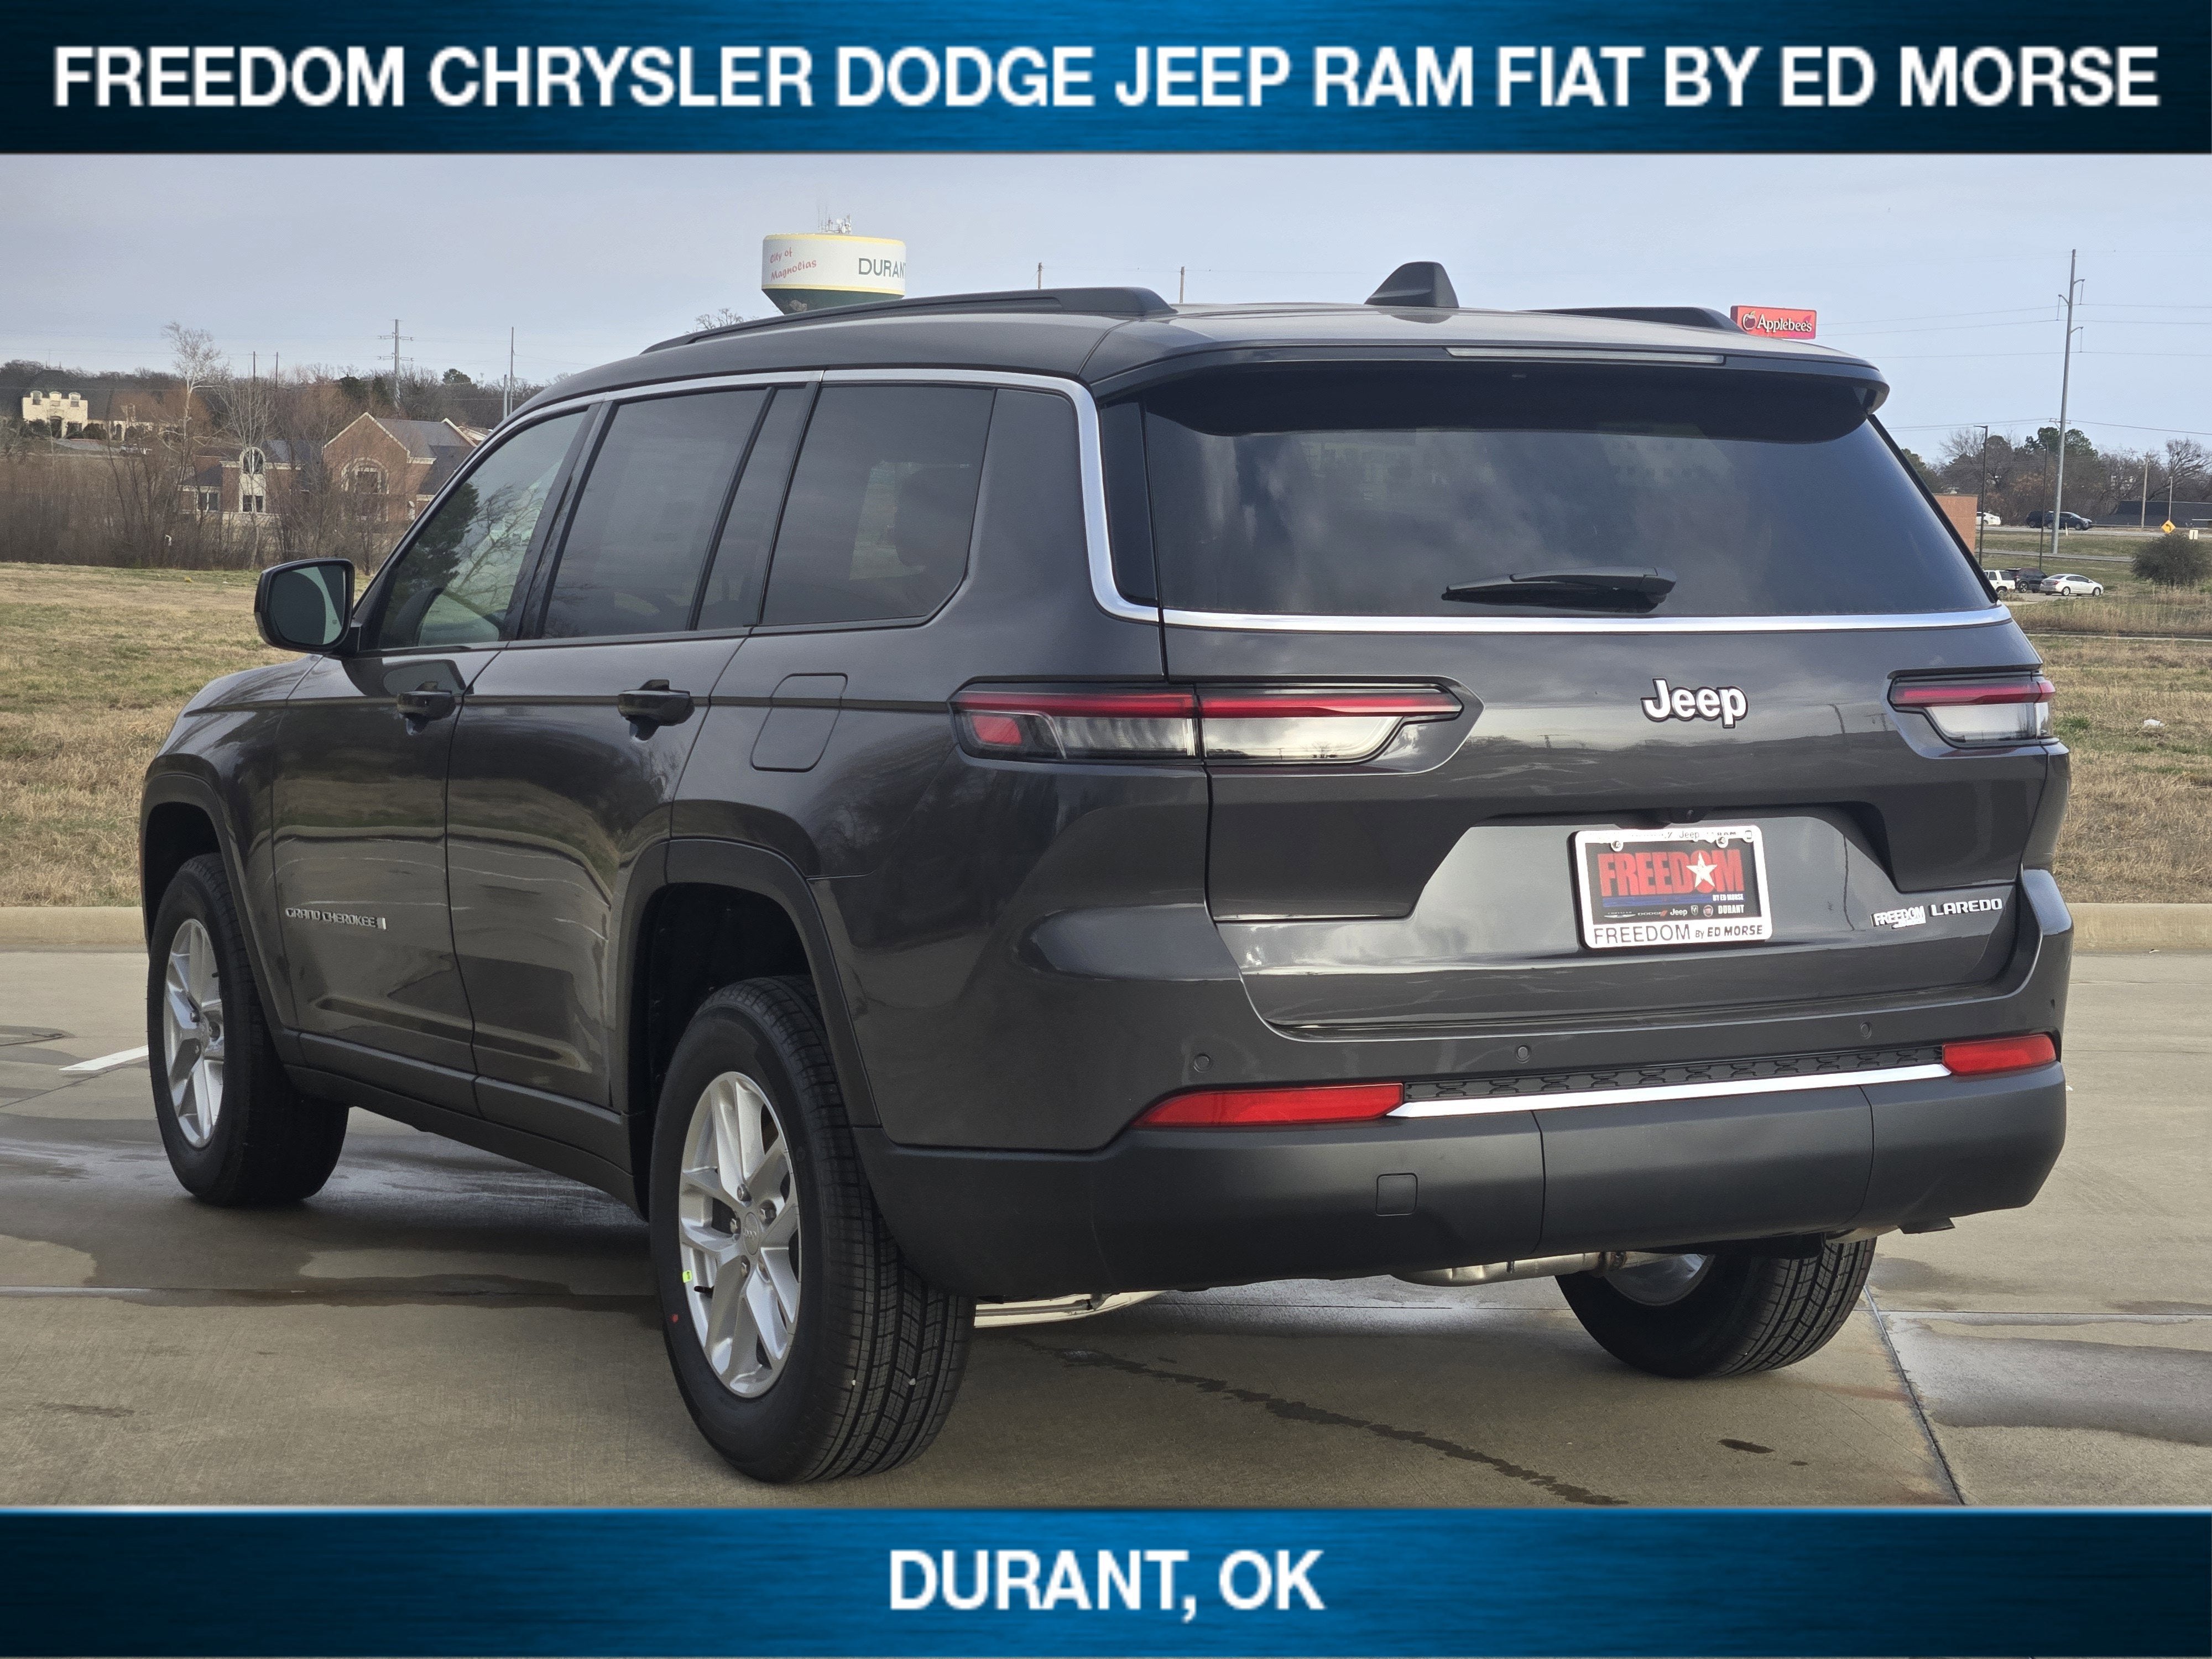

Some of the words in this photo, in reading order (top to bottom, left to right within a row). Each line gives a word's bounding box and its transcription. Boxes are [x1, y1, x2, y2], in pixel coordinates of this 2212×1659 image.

[770, 252, 782, 263] City
[784, 247, 792, 258] of
[770, 259, 817, 281] Magnolias
[1757, 314, 1812, 333] Applebee's
[1641, 678, 1749, 728] Jeep
[1598, 849, 1745, 896] FREEDOM
[1670, 908, 1687, 916] Jeep
[1718, 904, 1745, 914] DURANT
[1873, 906, 1926, 926] FREEDOM
[1930, 898, 2003, 916] LAREDO
[285, 907, 321, 920] GRAND
[322, 911, 377, 928] CHEROKEE
[1594, 924, 1690, 944] FREEDOM
[1707, 926, 1720, 937] ED
[1724, 924, 1763, 936] MORSE
